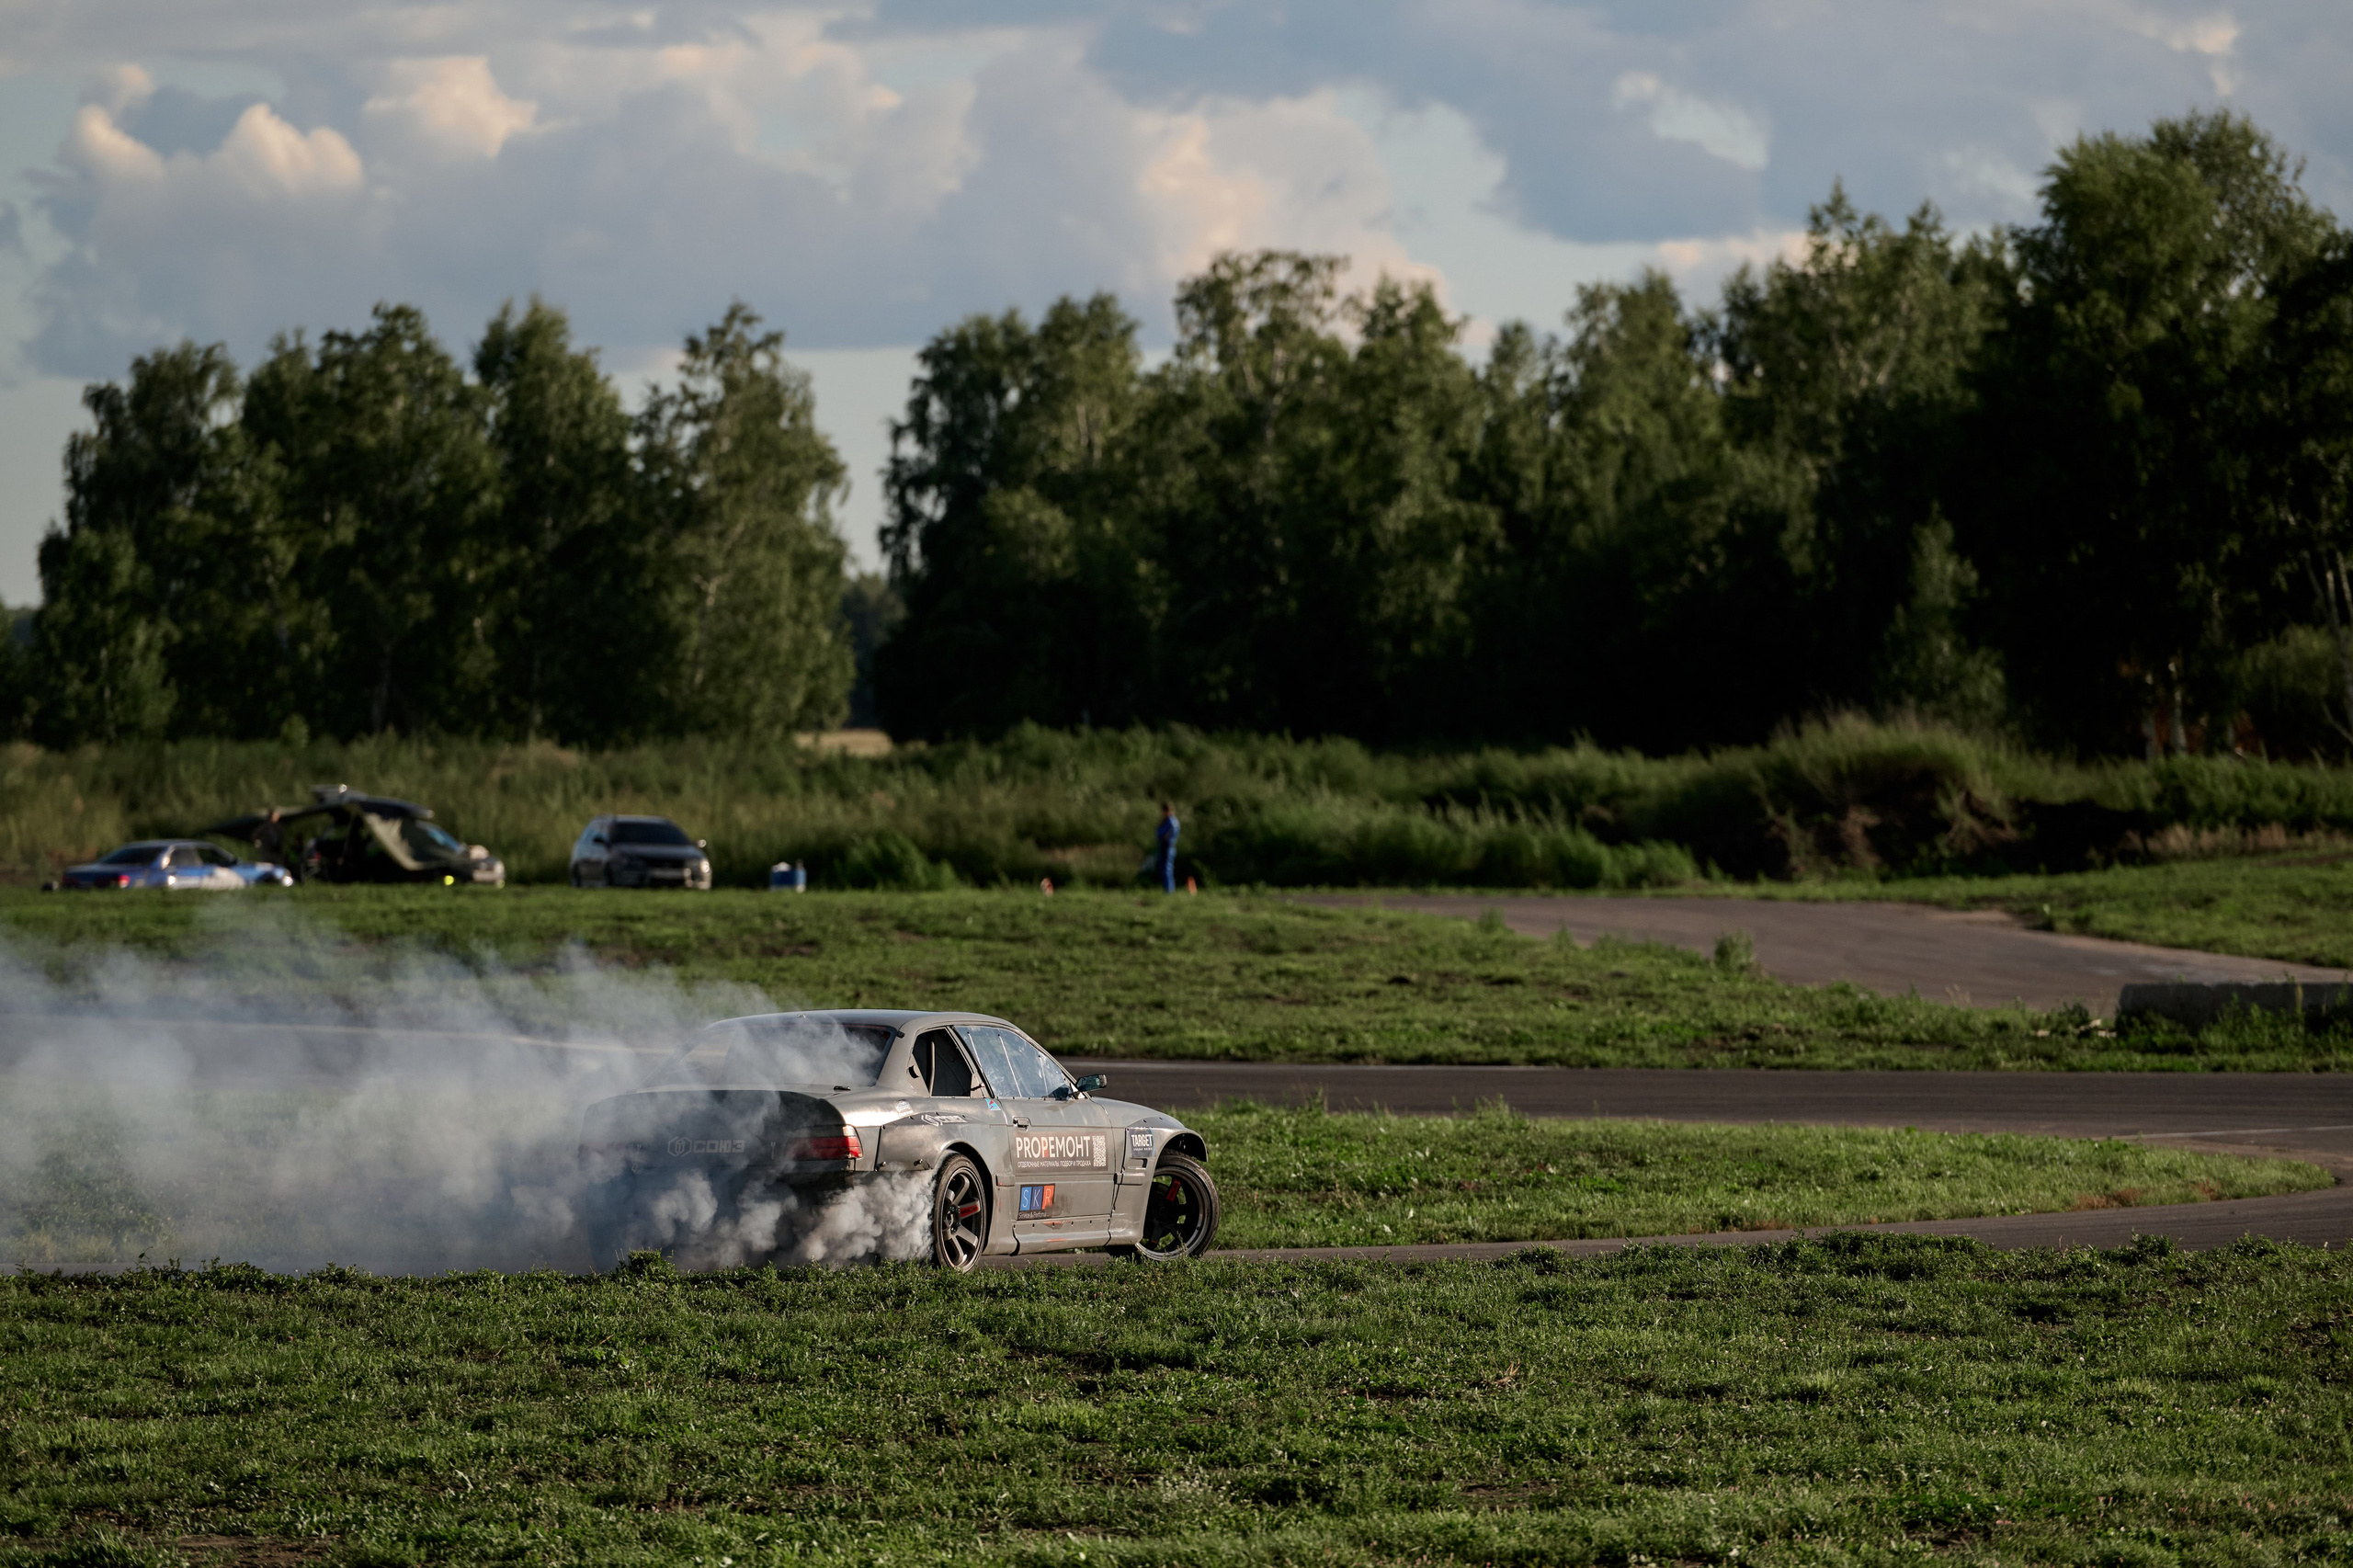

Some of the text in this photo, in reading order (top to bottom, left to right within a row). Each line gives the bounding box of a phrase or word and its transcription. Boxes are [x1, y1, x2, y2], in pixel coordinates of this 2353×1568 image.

[693, 1139, 745, 1153] СОЮЗ
[1131, 1134, 1153, 1147] TARGET
[1022, 1188, 1051, 1208] SKR
